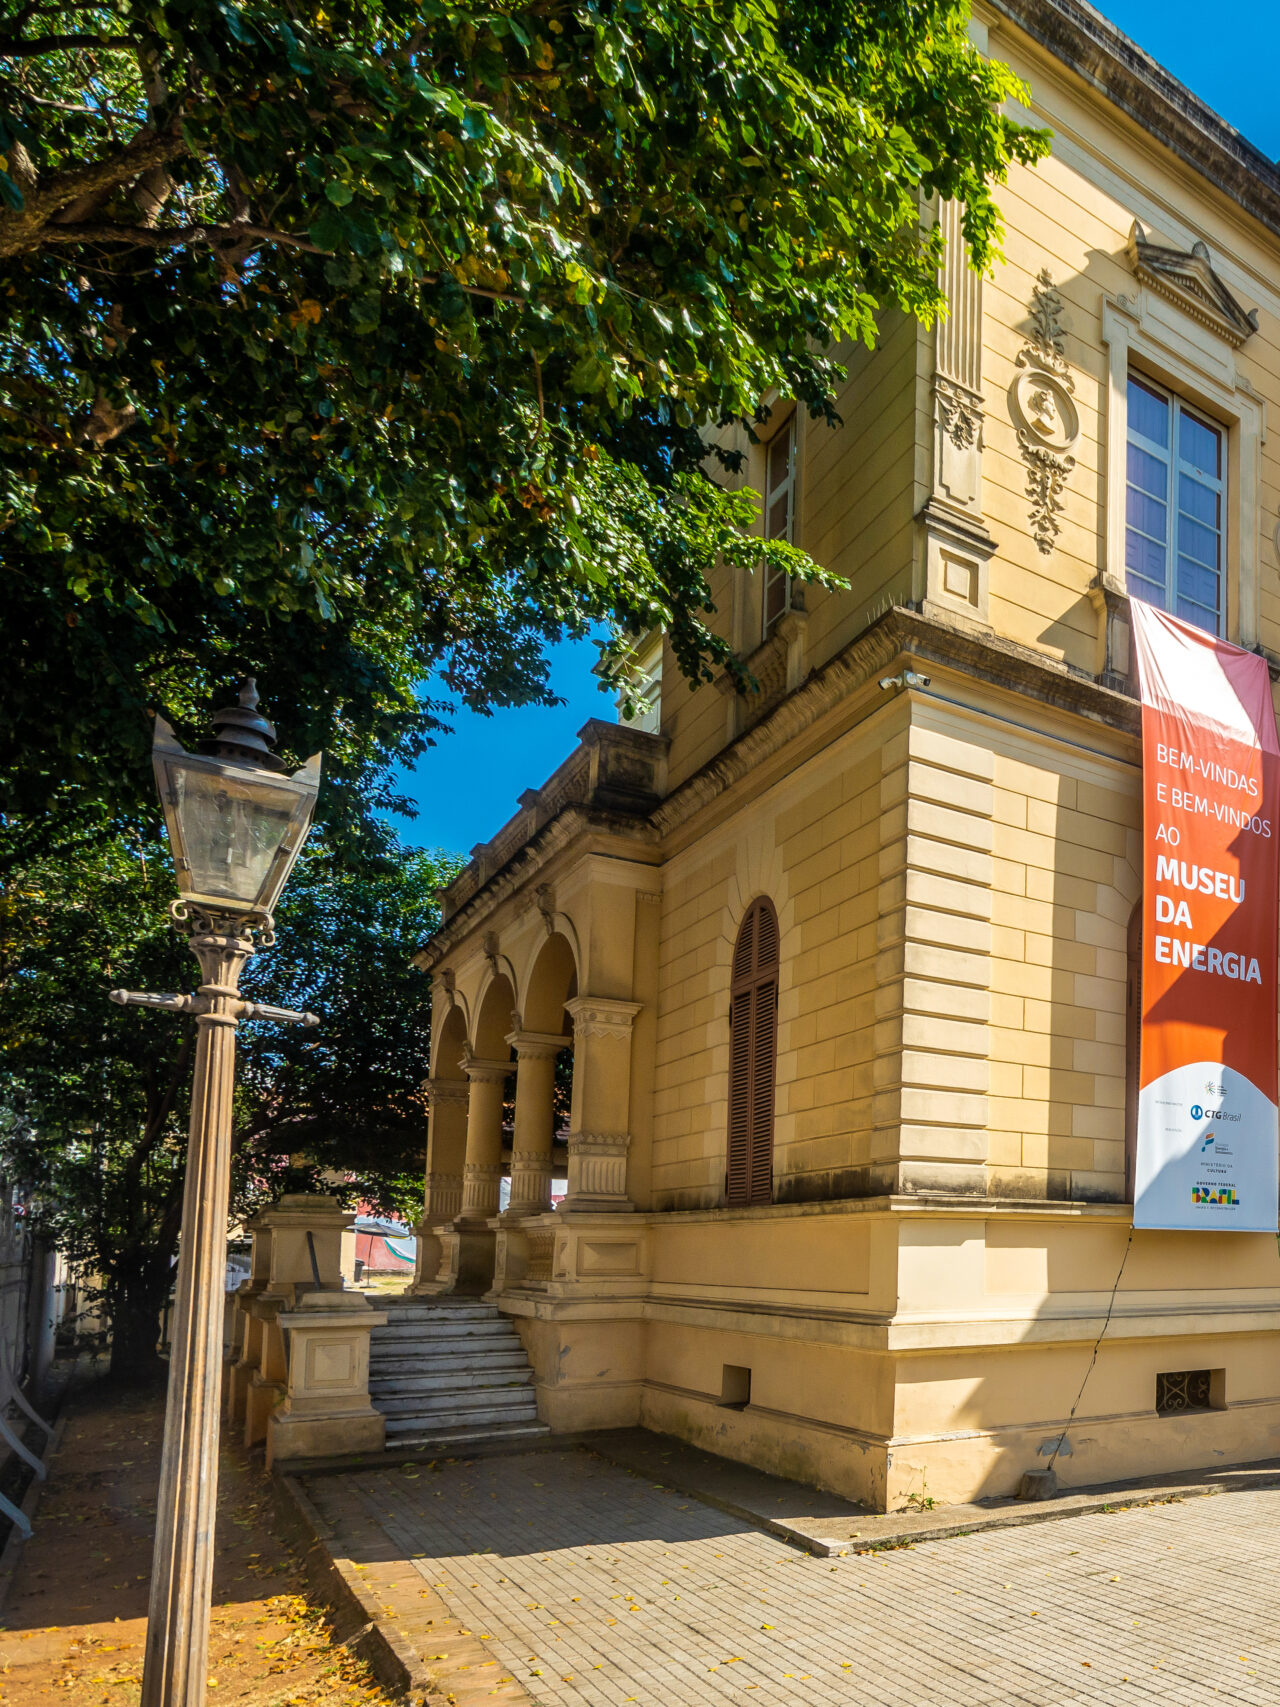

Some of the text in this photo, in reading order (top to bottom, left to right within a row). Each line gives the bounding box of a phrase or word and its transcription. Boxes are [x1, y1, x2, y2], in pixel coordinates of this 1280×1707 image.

[1157, 743, 1258, 797] BEM-VINDAS
[1156, 782, 1272, 839] E BEM-VINDOS
[1155, 823, 1180, 846] AO
[1156, 854, 1245, 904] MUSEU
[1155, 894, 1193, 930] DA
[1155, 935, 1262, 985] ENERGIA
[1204, 1109, 1242, 1122] CTG Brasil
[1191, 1187, 1240, 1205] BRASIL
